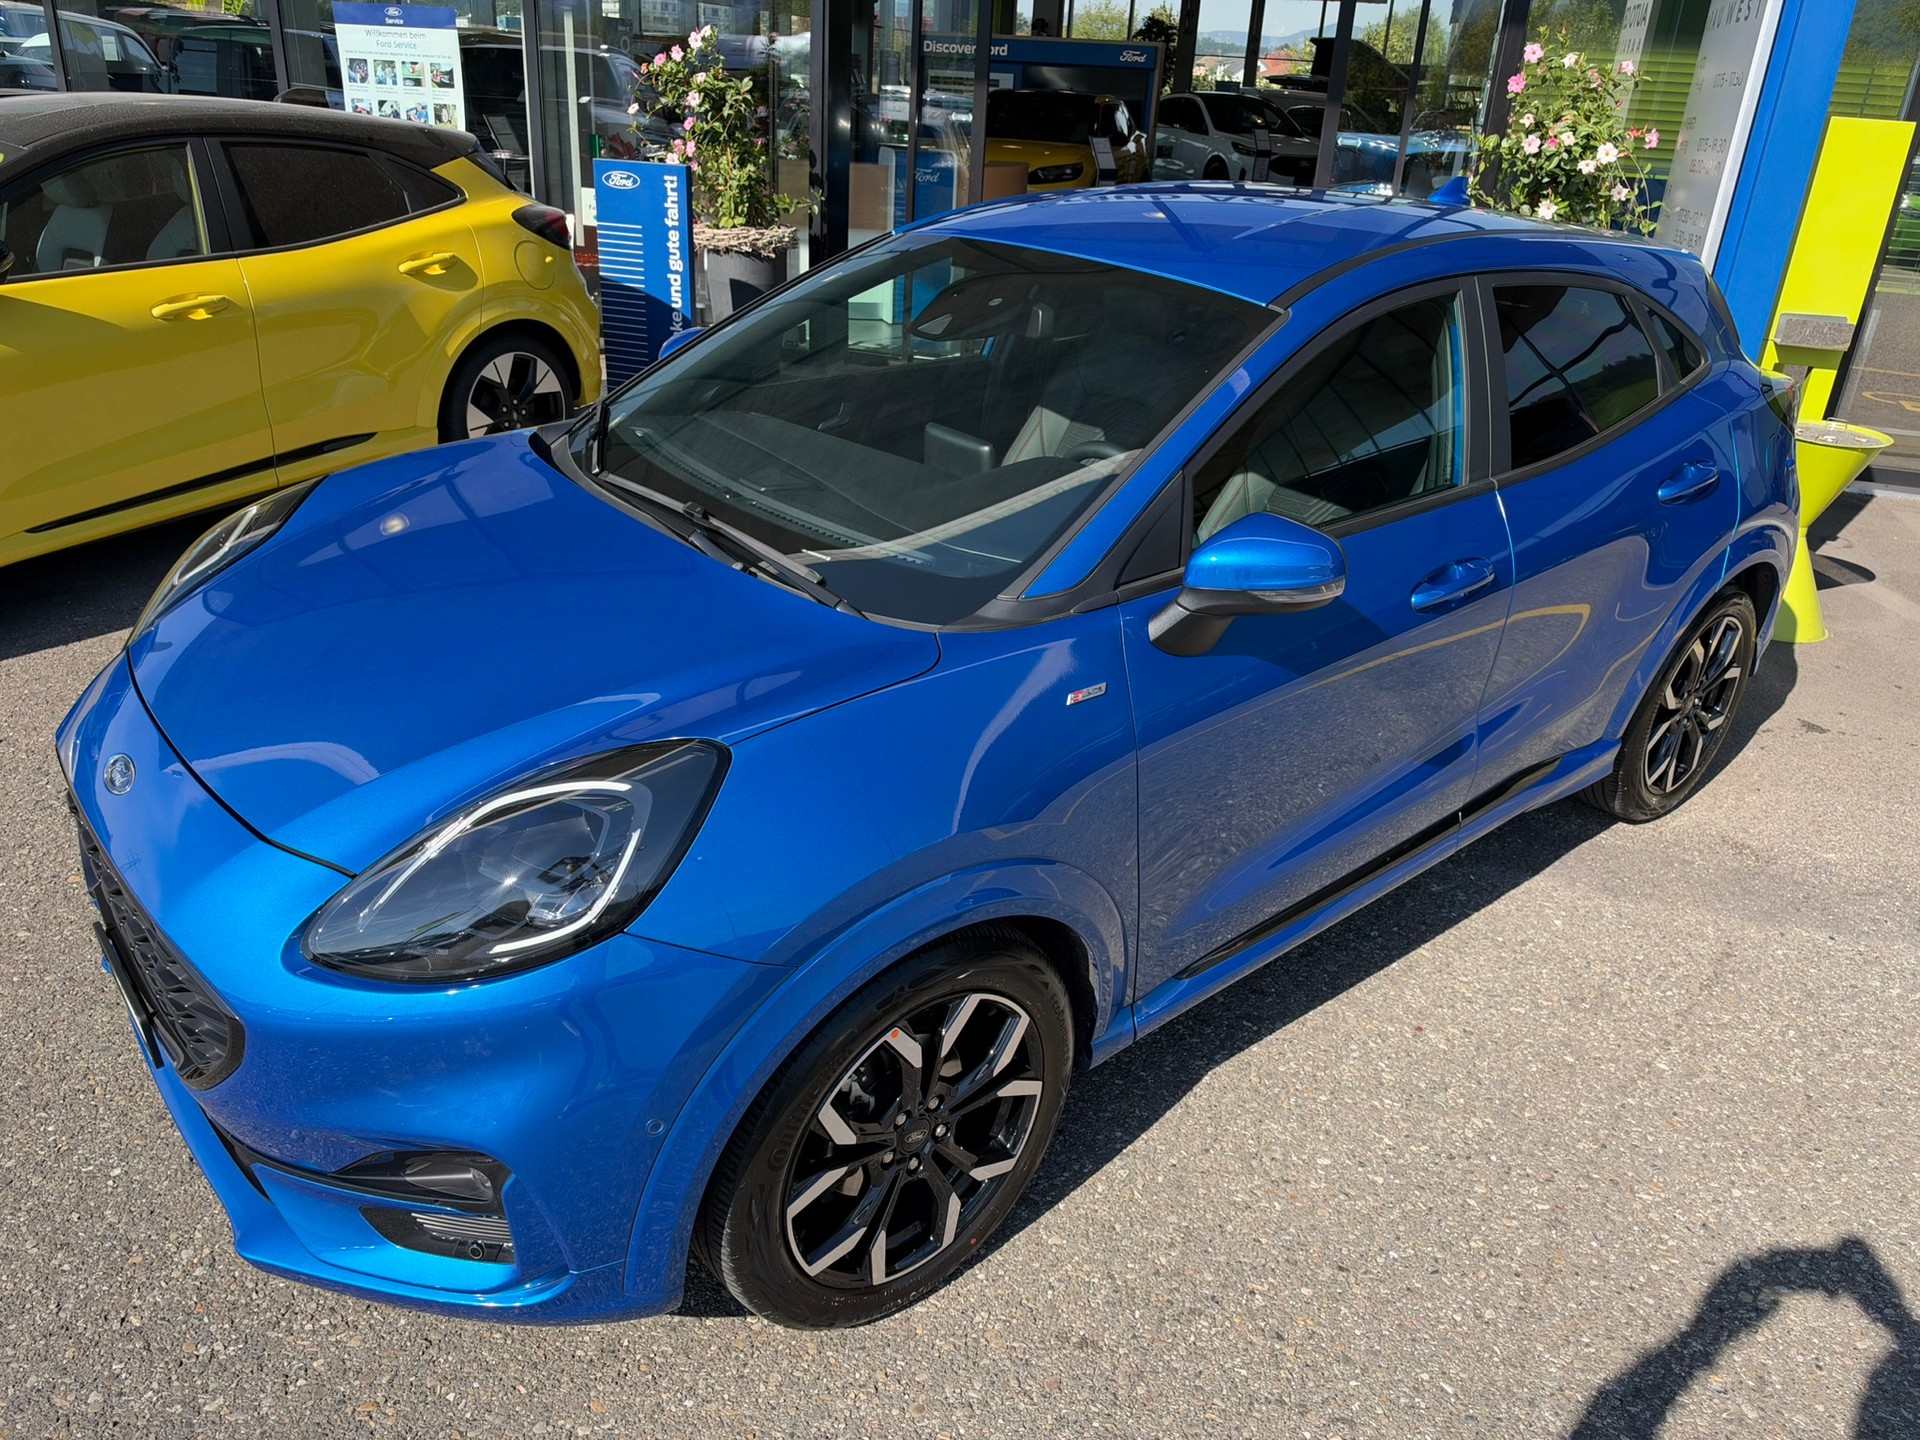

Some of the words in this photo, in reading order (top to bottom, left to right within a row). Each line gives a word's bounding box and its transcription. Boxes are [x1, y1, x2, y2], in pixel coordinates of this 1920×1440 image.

[385, 17, 404, 25] Service
[365, 29, 408, 39] Willkommen
[409, 31, 427, 40] beim
[376, 40, 392, 48] Ford
[393, 41, 417, 50] Service
[923, 40, 975, 55] Discover
[990, 44, 1008, 56] ord
[1119, 50, 1148, 63] Ford
[608, 171, 634, 188] Ford
[663, 175, 679, 227] fahrt!
[668, 230, 683, 273] gute
[667, 274, 682, 308] und
[111, 761, 128, 787] Ford
